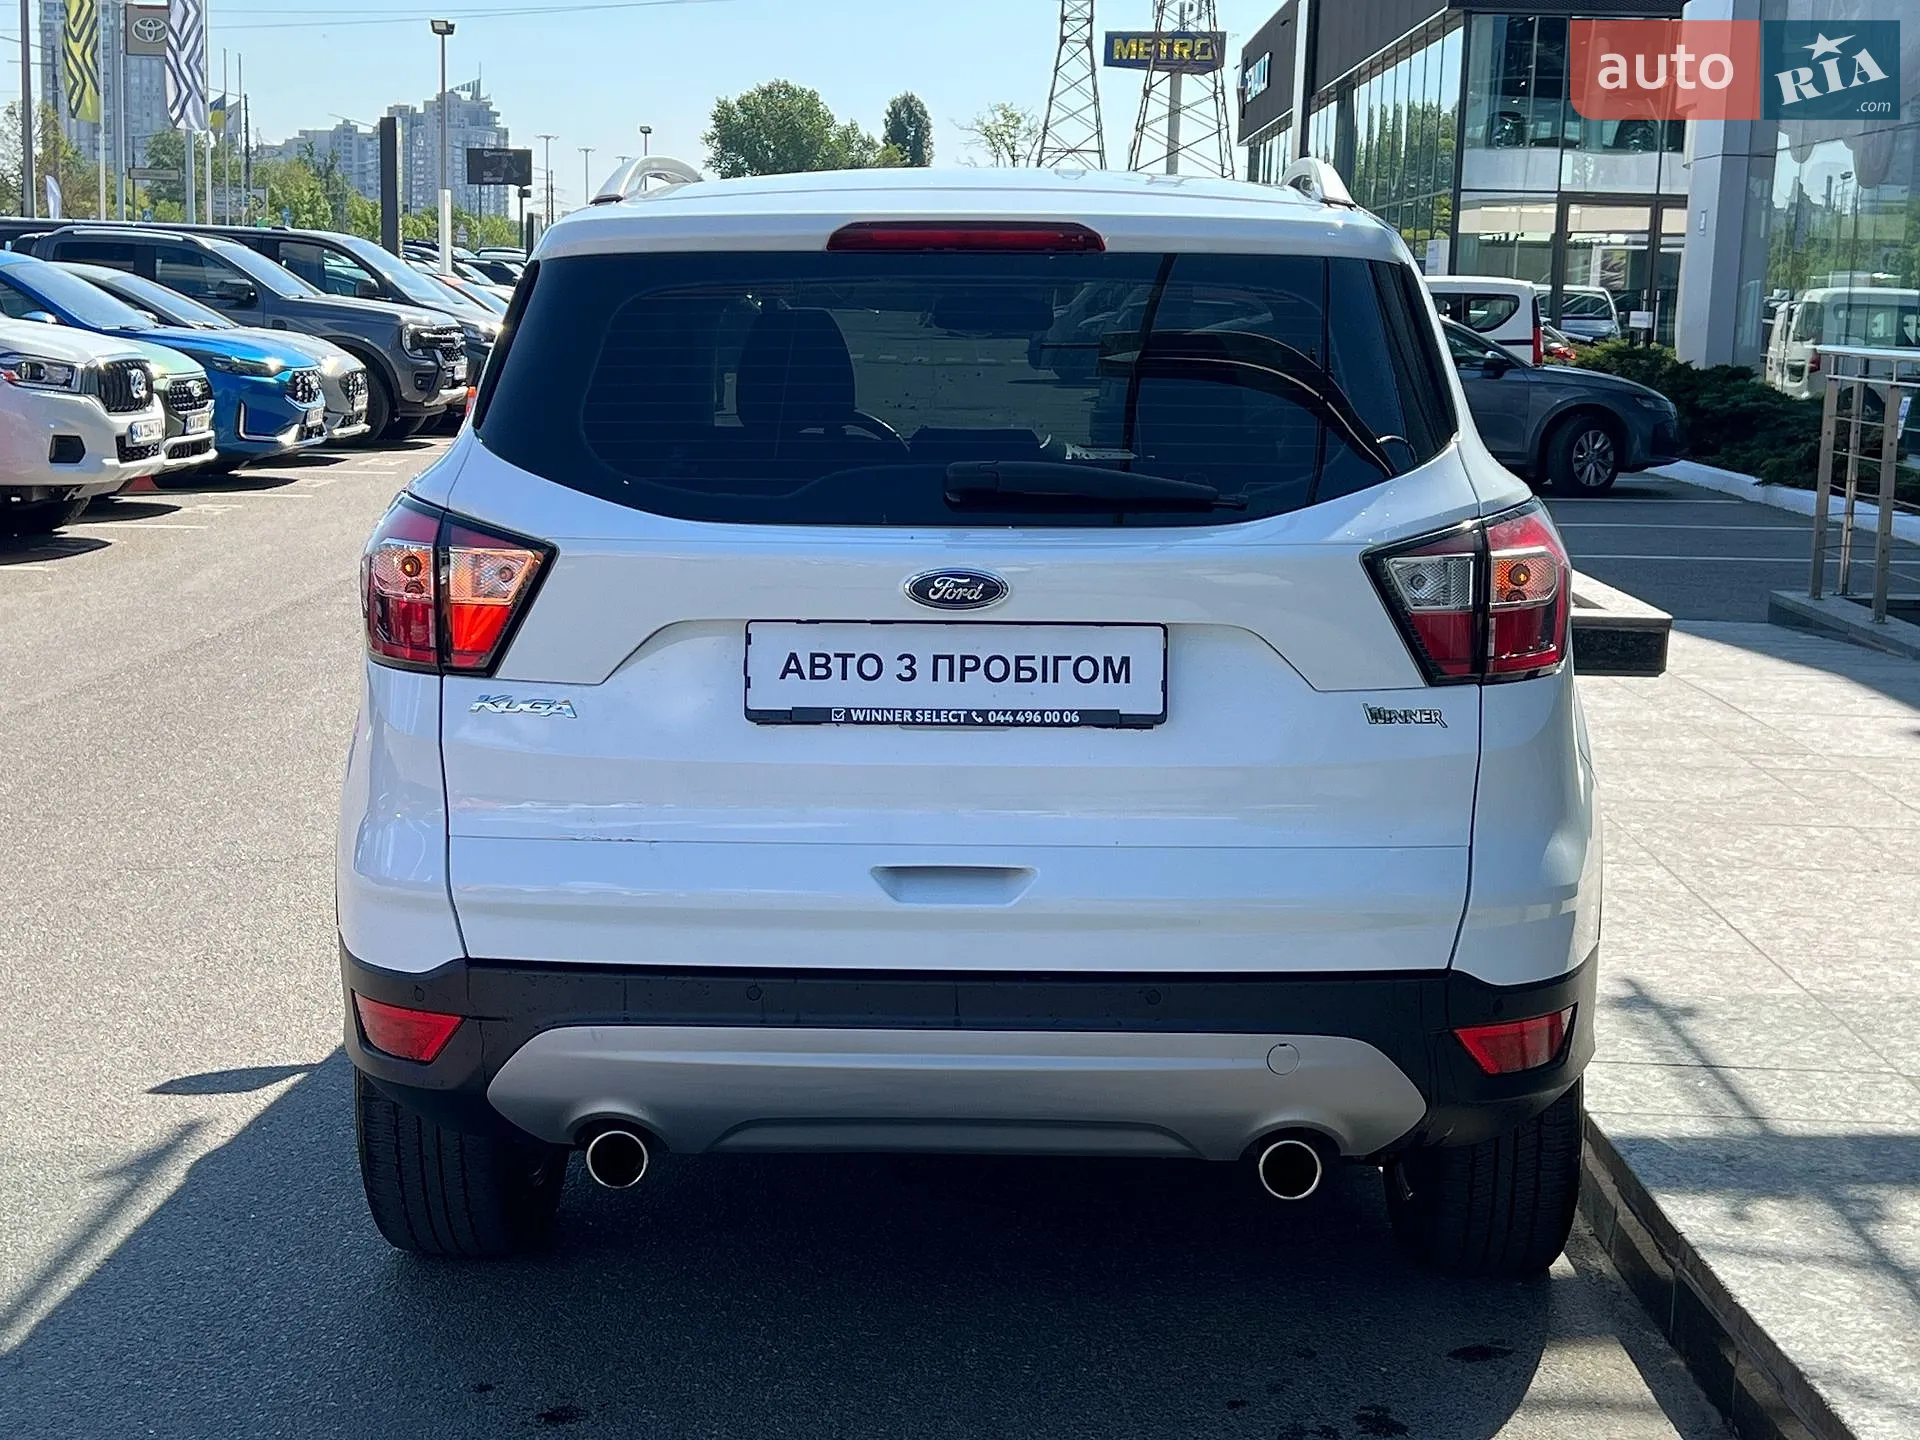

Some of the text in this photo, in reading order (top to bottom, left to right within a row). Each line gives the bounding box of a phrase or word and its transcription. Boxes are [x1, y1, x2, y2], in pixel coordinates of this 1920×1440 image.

[1113, 38, 1213, 60] METRO
[928, 577, 984, 600] Ford
[779, 652, 884, 681] АВТО
[932, 654, 1131, 684] ПРОБІГОМ
[469, 695, 577, 718] KUGA
[851, 708, 1080, 724] WINNER SELECT 044 496 00 06
[1363, 703, 1447, 728] WINNER
